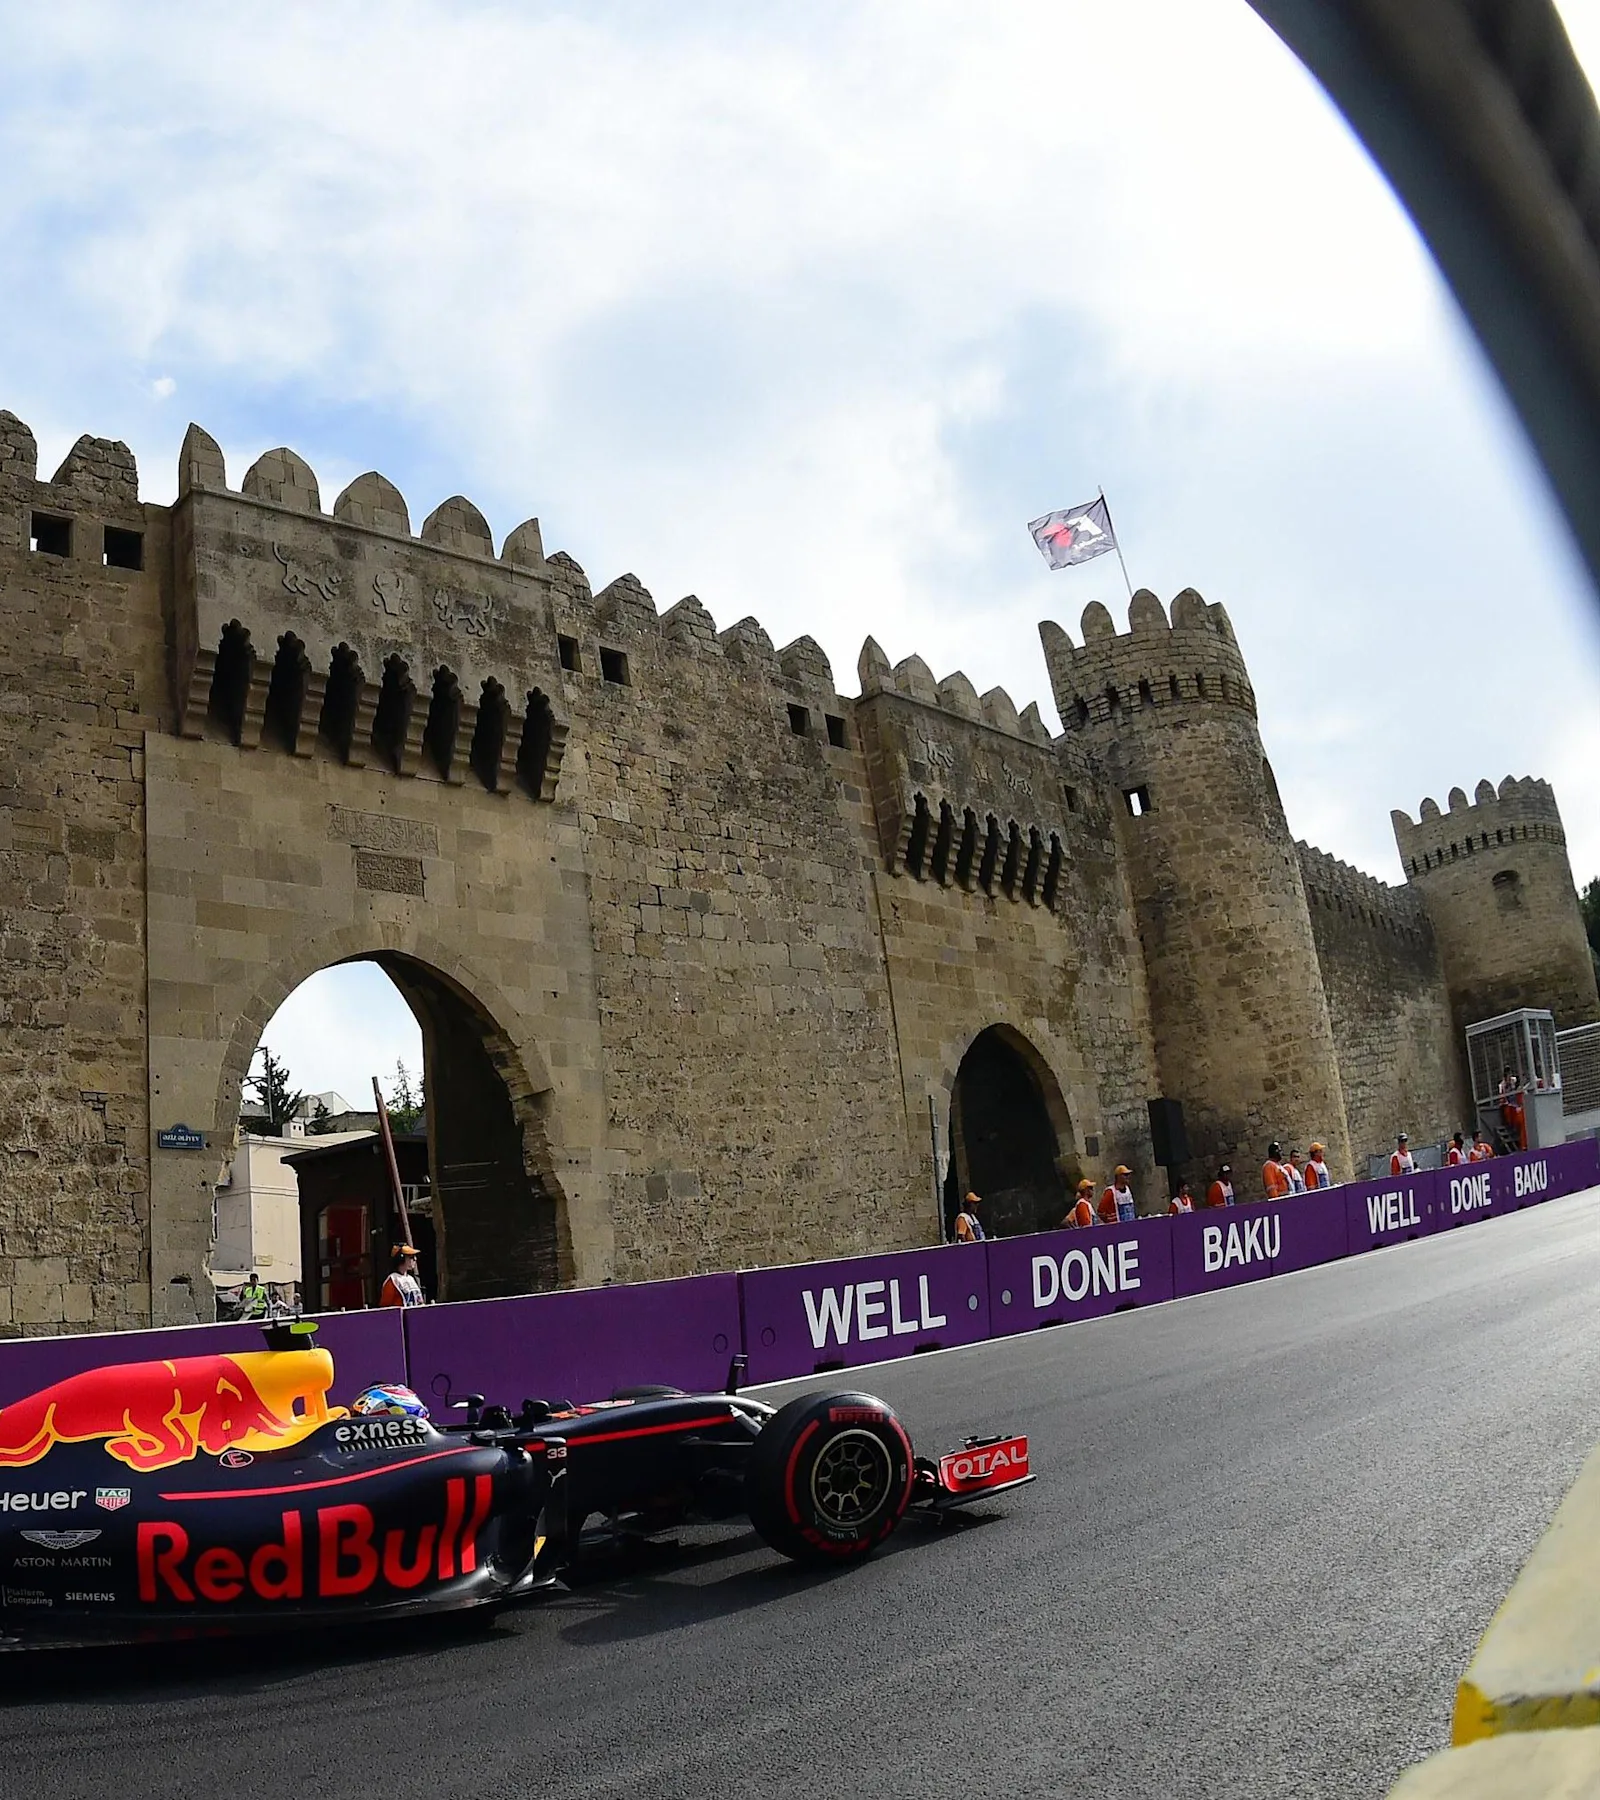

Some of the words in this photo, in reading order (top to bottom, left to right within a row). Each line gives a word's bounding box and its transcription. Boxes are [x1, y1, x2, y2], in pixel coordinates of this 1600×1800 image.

[1366, 1189, 1421, 1234] WELL
[1449, 1172, 1492, 1214] DONE
[1514, 1159, 1548, 1198] BAKU
[801, 1275, 947, 1349] WELL
[1031, 1240, 1141, 1308] DONE
[1202, 1214, 1281, 1273] BAKU
[335, 1417, 429, 1442] exness
[547, 1446, 568, 1459] 33
[940, 1446, 1028, 1484] TOTAL
[99, 1489, 129, 1497] TAG
[13, 1557, 55, 1568] ASTON
[60, 1556, 112, 1568] MARTIN
[6, 1587, 45, 1597] Platform
[65, 1592, 116, 1602] SIEMENS
[6, 1596, 53, 1607] Computing
